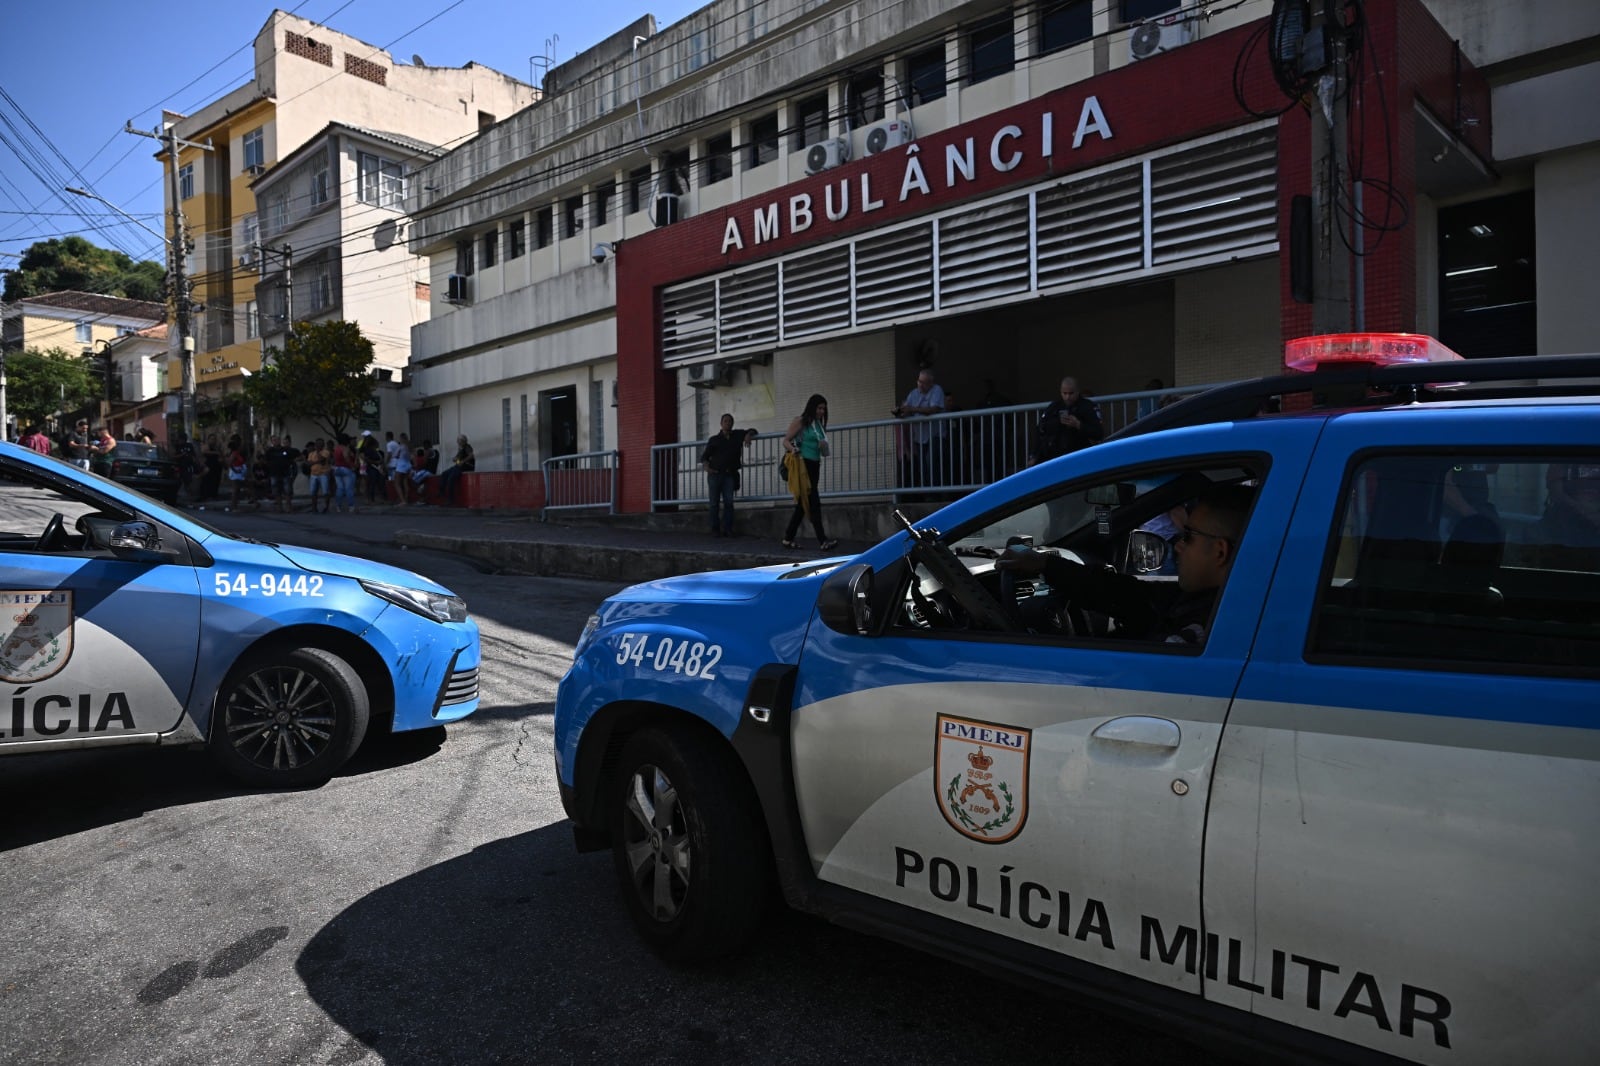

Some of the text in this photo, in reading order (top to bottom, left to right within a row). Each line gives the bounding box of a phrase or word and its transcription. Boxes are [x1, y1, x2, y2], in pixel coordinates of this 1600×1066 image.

[720, 95, 1113, 254] AMBULÂNCIA
[215, 572, 324, 597] 54-9442
[616, 633, 723, 681] 54-0482
[0, 686, 136, 739] ÍCIA
[944, 721, 1025, 748] PMERJ
[968, 803, 991, 816] 1809
[895, 846, 1453, 1050] POLÍCIA MILITAR
